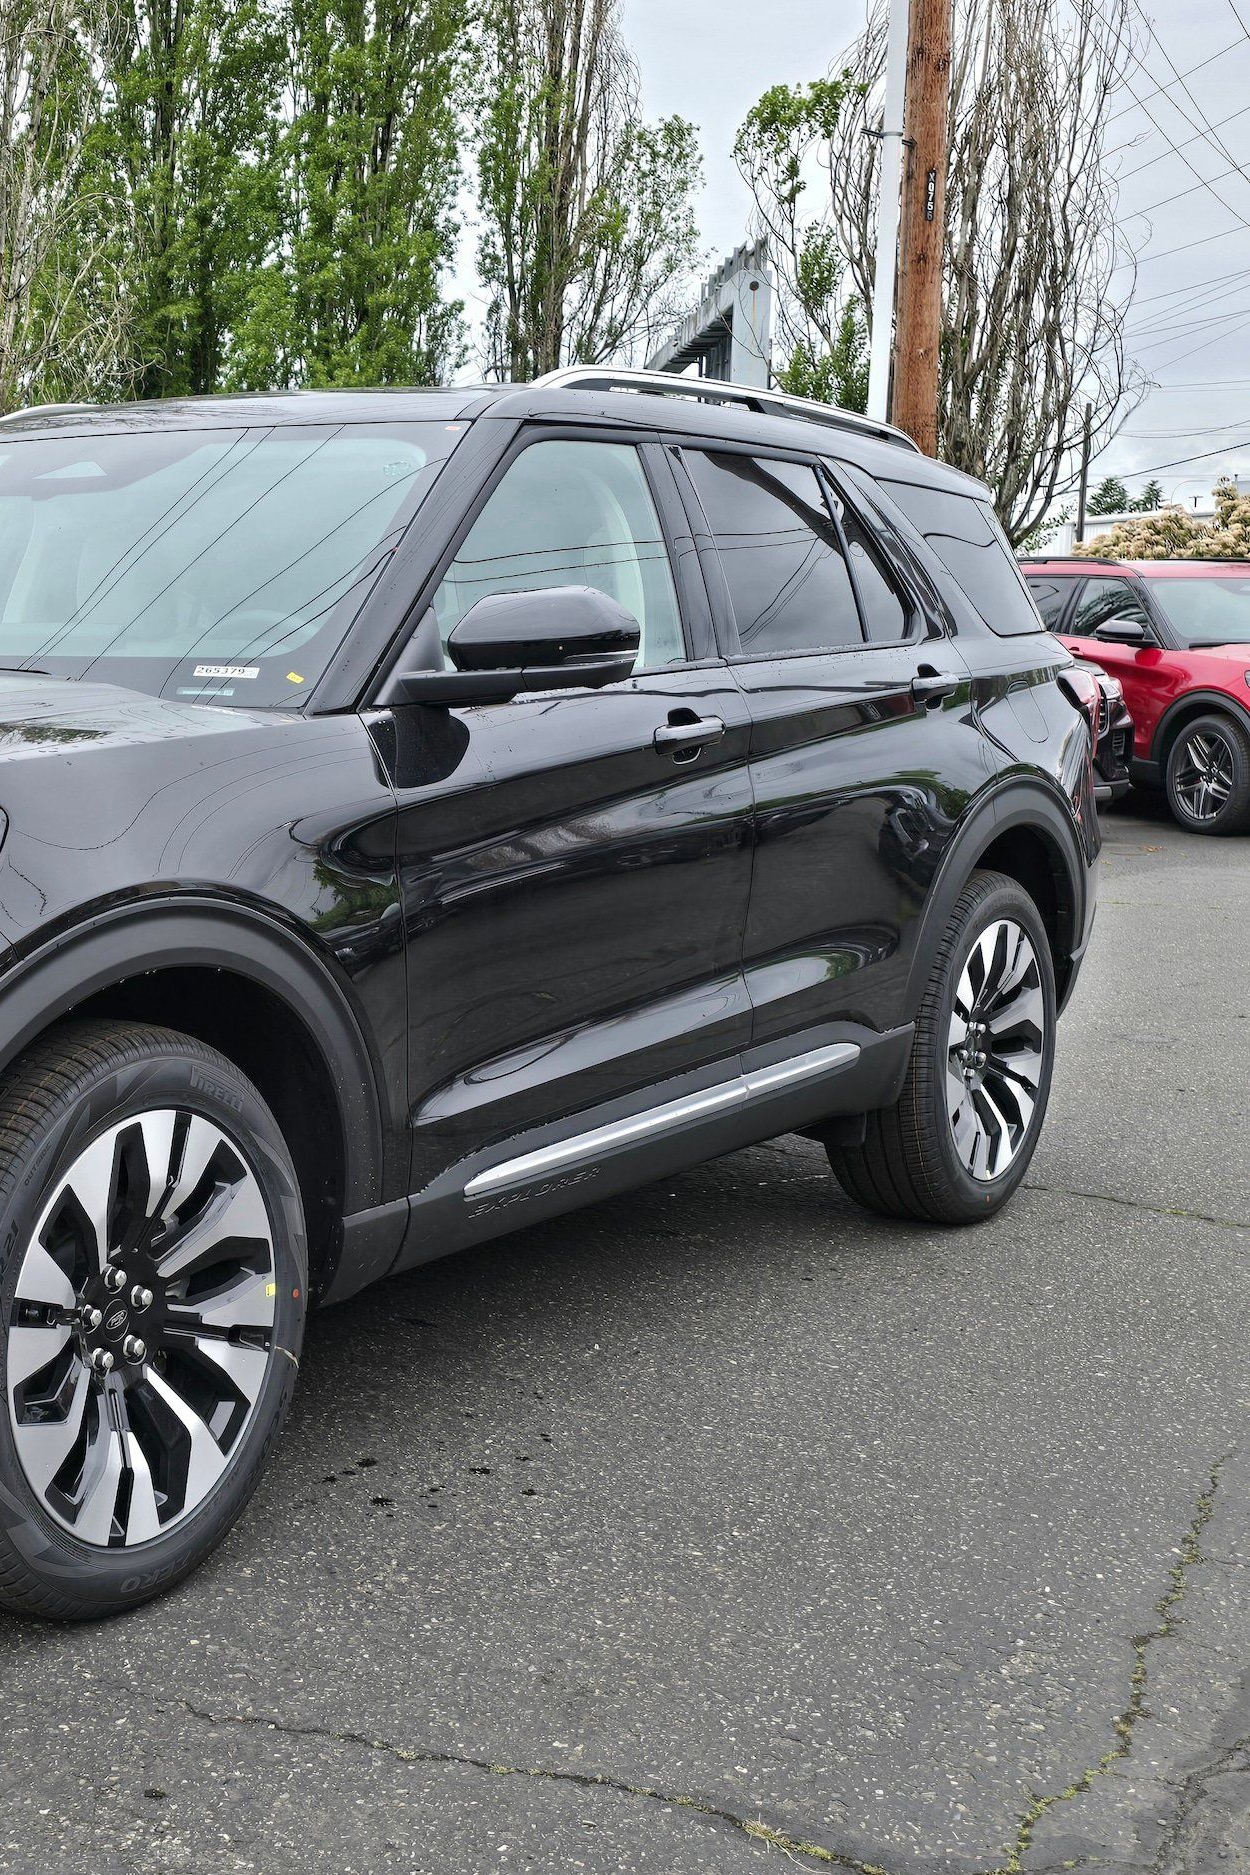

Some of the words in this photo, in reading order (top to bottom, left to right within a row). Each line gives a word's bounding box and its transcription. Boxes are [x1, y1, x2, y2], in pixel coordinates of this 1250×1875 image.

[196, 666, 245, 676] 265379
[190, 1065, 243, 1112] PIRELLI
[24, 1140, 52, 1186] OUTSIDE
[467, 1167, 601, 1219] EXPLORER
